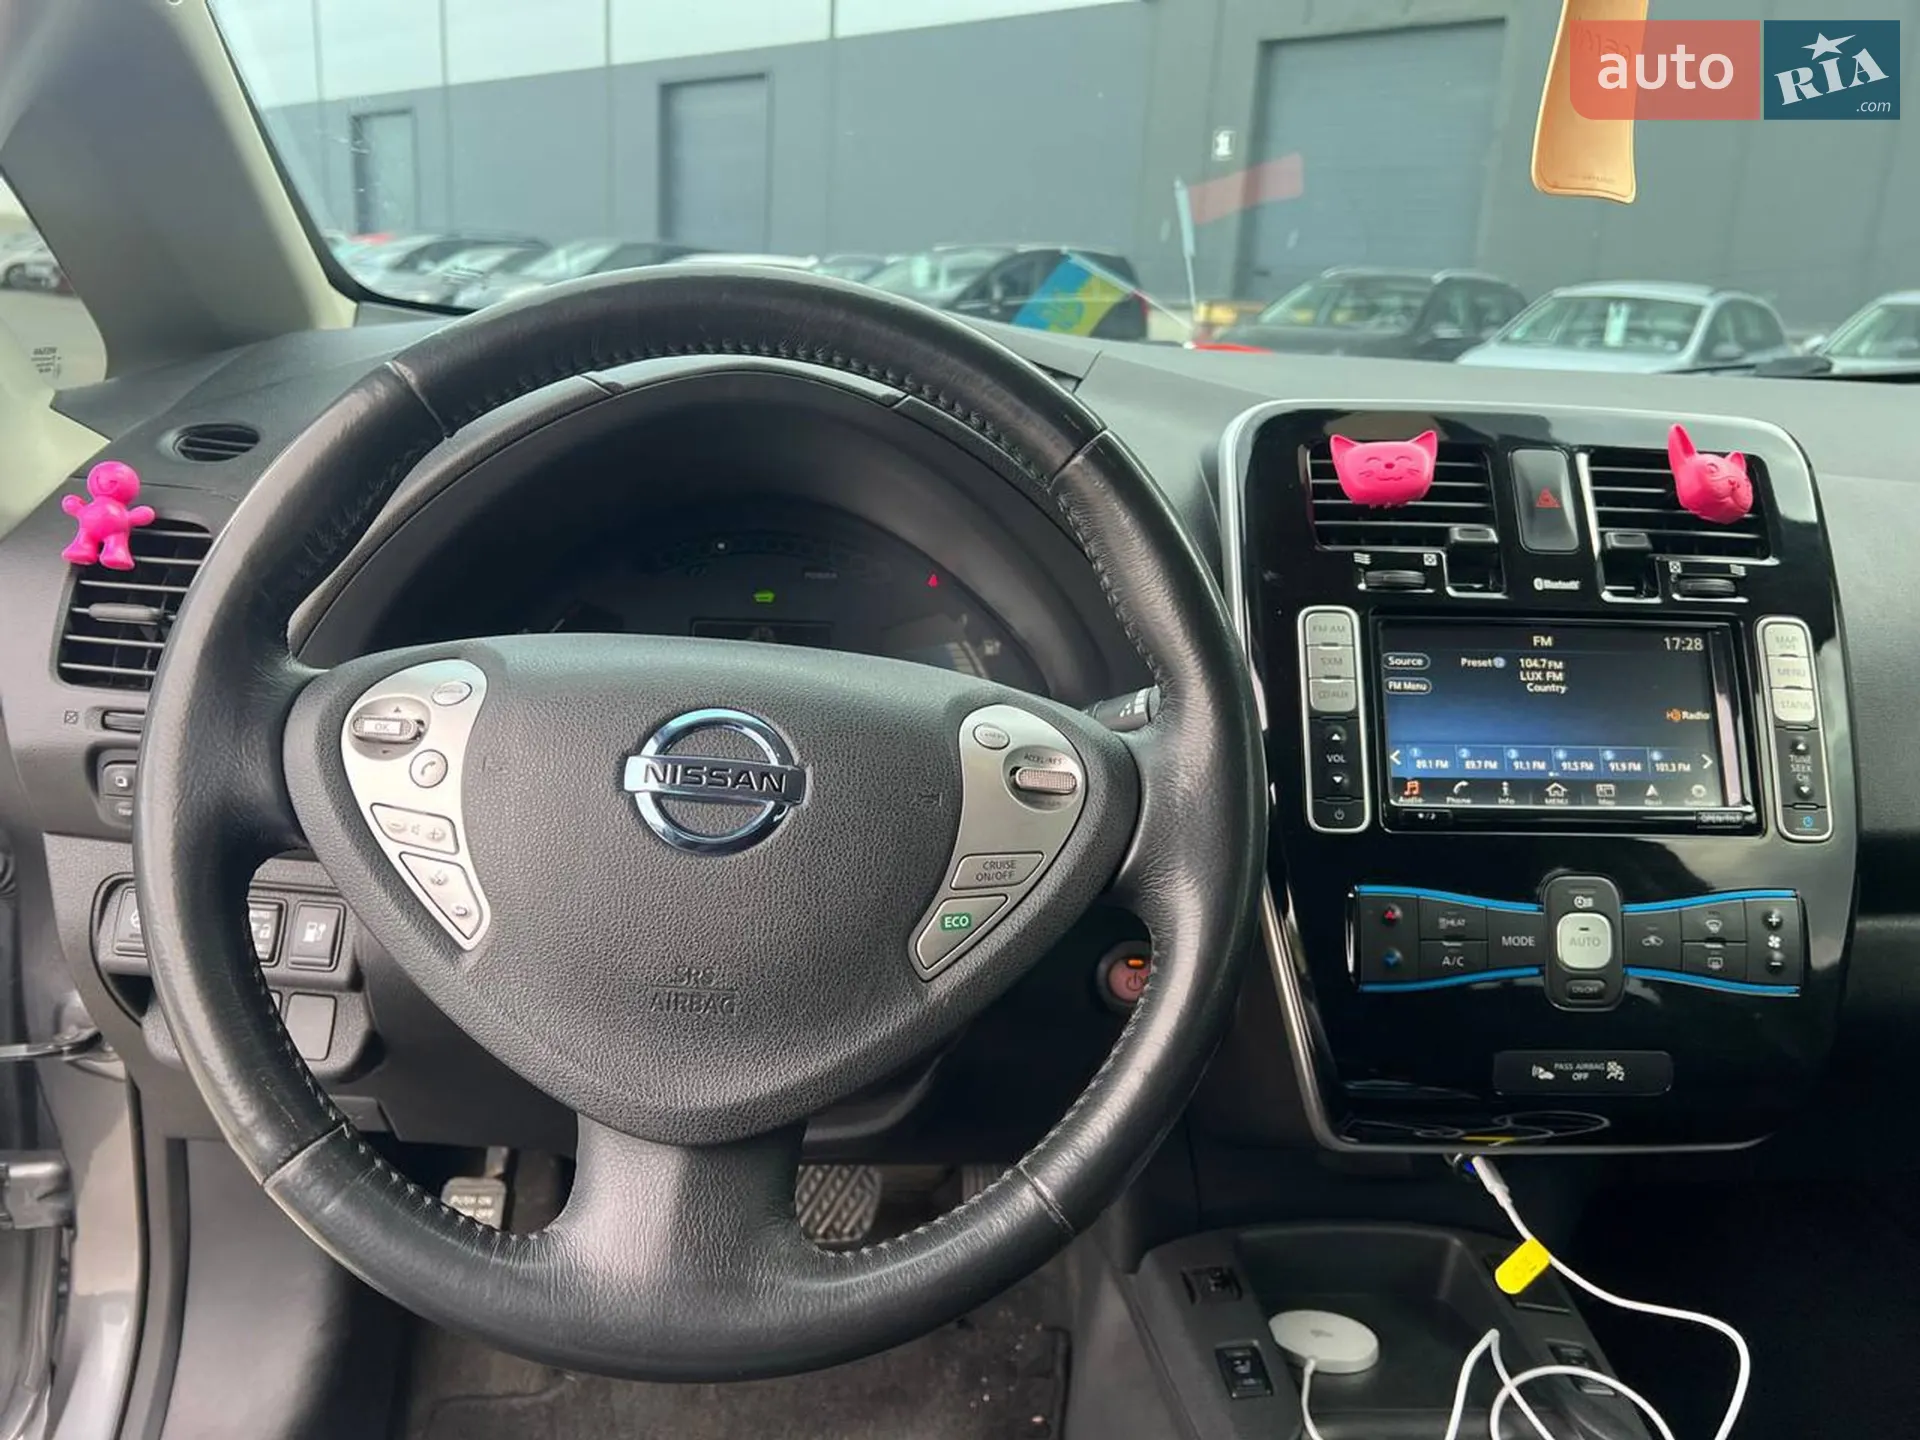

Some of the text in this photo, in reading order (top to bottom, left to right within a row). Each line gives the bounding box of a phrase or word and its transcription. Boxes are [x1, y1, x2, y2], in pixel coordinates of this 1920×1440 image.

[1532, 635, 1553, 648] FM
[1663, 636, 1704, 651] 17:28
[1387, 656, 1424, 667] Source
[1460, 657, 1493, 668] Preset
[1519, 658, 1563, 670] 104.7 FM
[1519, 671, 1564, 682] LUX FM
[1387, 681, 1428, 692] FM Menu
[1526, 681, 1567, 695] Country
[1682, 710, 1710, 720] Radio
[1326, 754, 1346, 763] VOL
[644, 764, 788, 793] NISSAN
[983, 860, 1017, 871] CRUISE
[976, 871, 1015, 881] ON/OFF
[944, 916, 969, 928] ECO
[1502, 935, 1535, 947] MODE
[1569, 936, 1601, 948] AUTO
[1442, 956, 1465, 967] A/C
[1553, 1062, 1605, 1071] PASS AIRBAG
[1571, 1071, 1589, 1081] OFF
